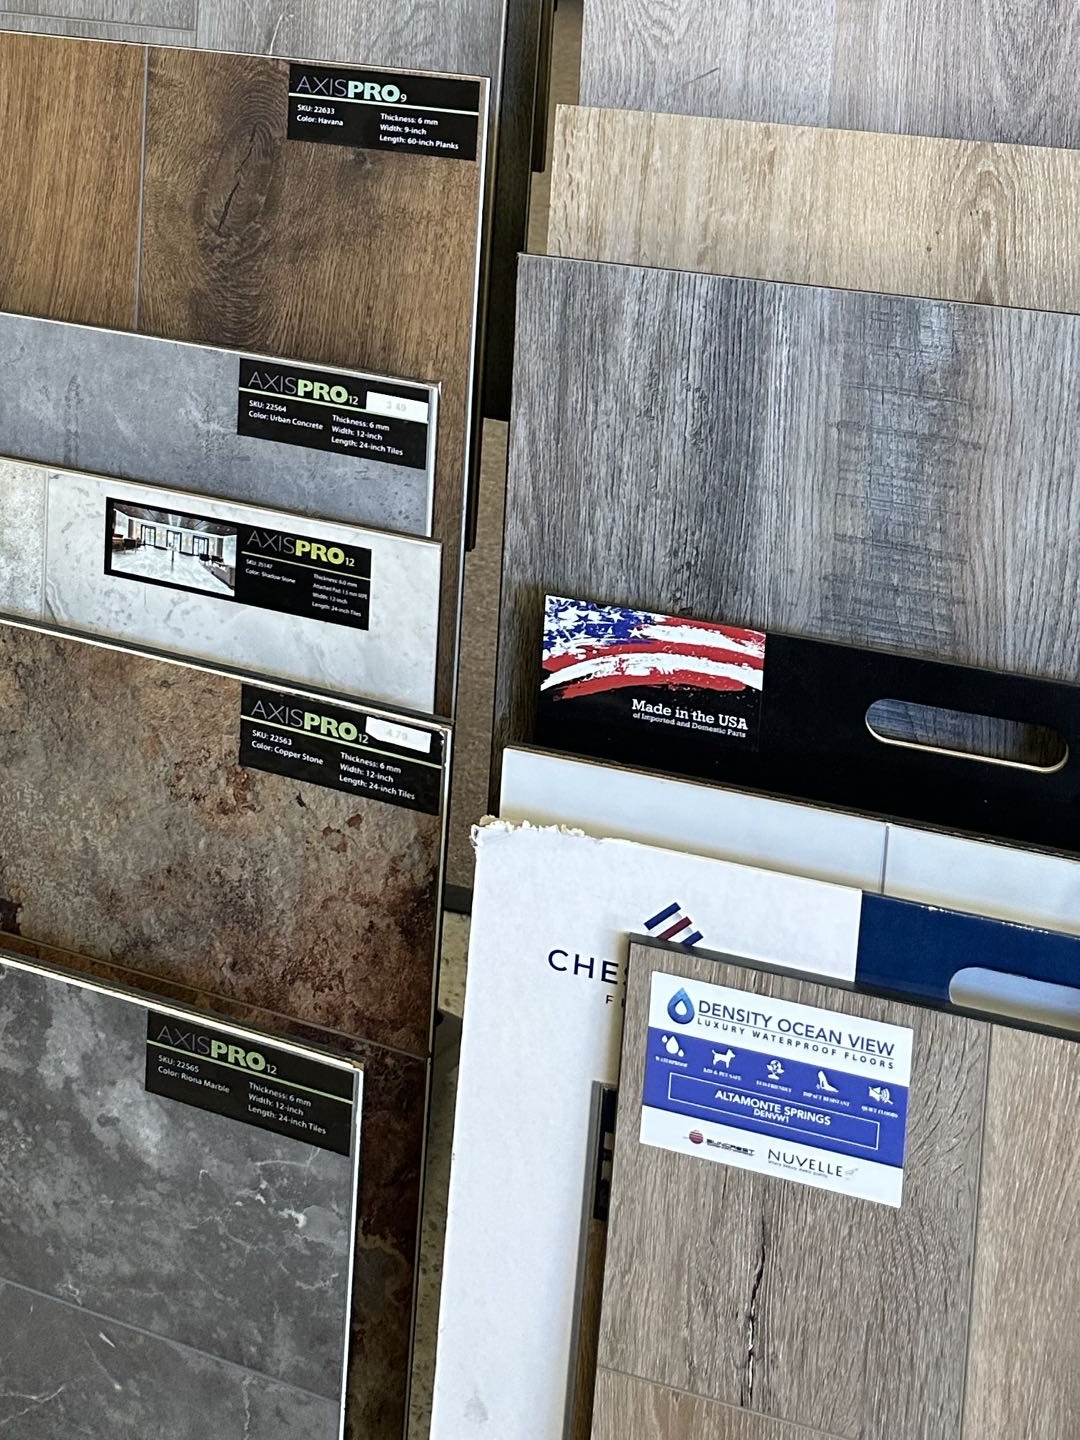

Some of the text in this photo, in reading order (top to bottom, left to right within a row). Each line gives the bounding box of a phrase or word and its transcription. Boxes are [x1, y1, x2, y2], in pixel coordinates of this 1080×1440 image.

[297, 104, 335, 114] SKU: 22633
[381, 113, 417, 123] Thickness:
[297, 115, 343, 126] Color: Havana
[380, 124, 427, 135] Width: 9-inch
[380, 135, 459, 150] Length: 60-inch Planks
[249, 399, 287, 412] SKU: 22564
[249, 411, 323, 430] Color: Urban Concrete
[332, 415, 368, 427] Thickness:
[332, 426, 383, 441] Width: 12-inch
[331, 436, 403, 456] Length: 24-inch Tiles
[632, 699, 748, 730] Made in the USA
[642, 714, 675, 725] Imported
[691, 723, 726, 734] Domestic
[727, 729, 746, 738] Parts
[252, 730, 292, 746] SKU: 22563
[251, 741, 324, 765] Color: Copper Stone
[340, 752, 378, 768] Thickness:
[386, 765, 402, 774] mm
[340, 764, 394, 783] Width: 12-inch
[339, 775, 415, 800] Length: 24-inch Tiles
[699, 1000, 895, 1056] DENSITY OCEAN VIEW
[698, 1018, 894, 1069] LUXURY WATERPROOF FLOORS
[158, 1055, 199, 1073] SKU: 22565
[158, 1066, 230, 1093] Color: Riona Marble
[249, 1082, 311, 1107] Thickness: 6 mm
[249, 1093, 304, 1116] Width: 12-inch
[715, 1090, 831, 1125] ALTAMONTE SPRINGS
[753, 1108, 790, 1124] DENVW1
[248, 1105, 326, 1135] Length: 24-inch Tiles
[768, 1148, 843, 1177] NUVELLE
